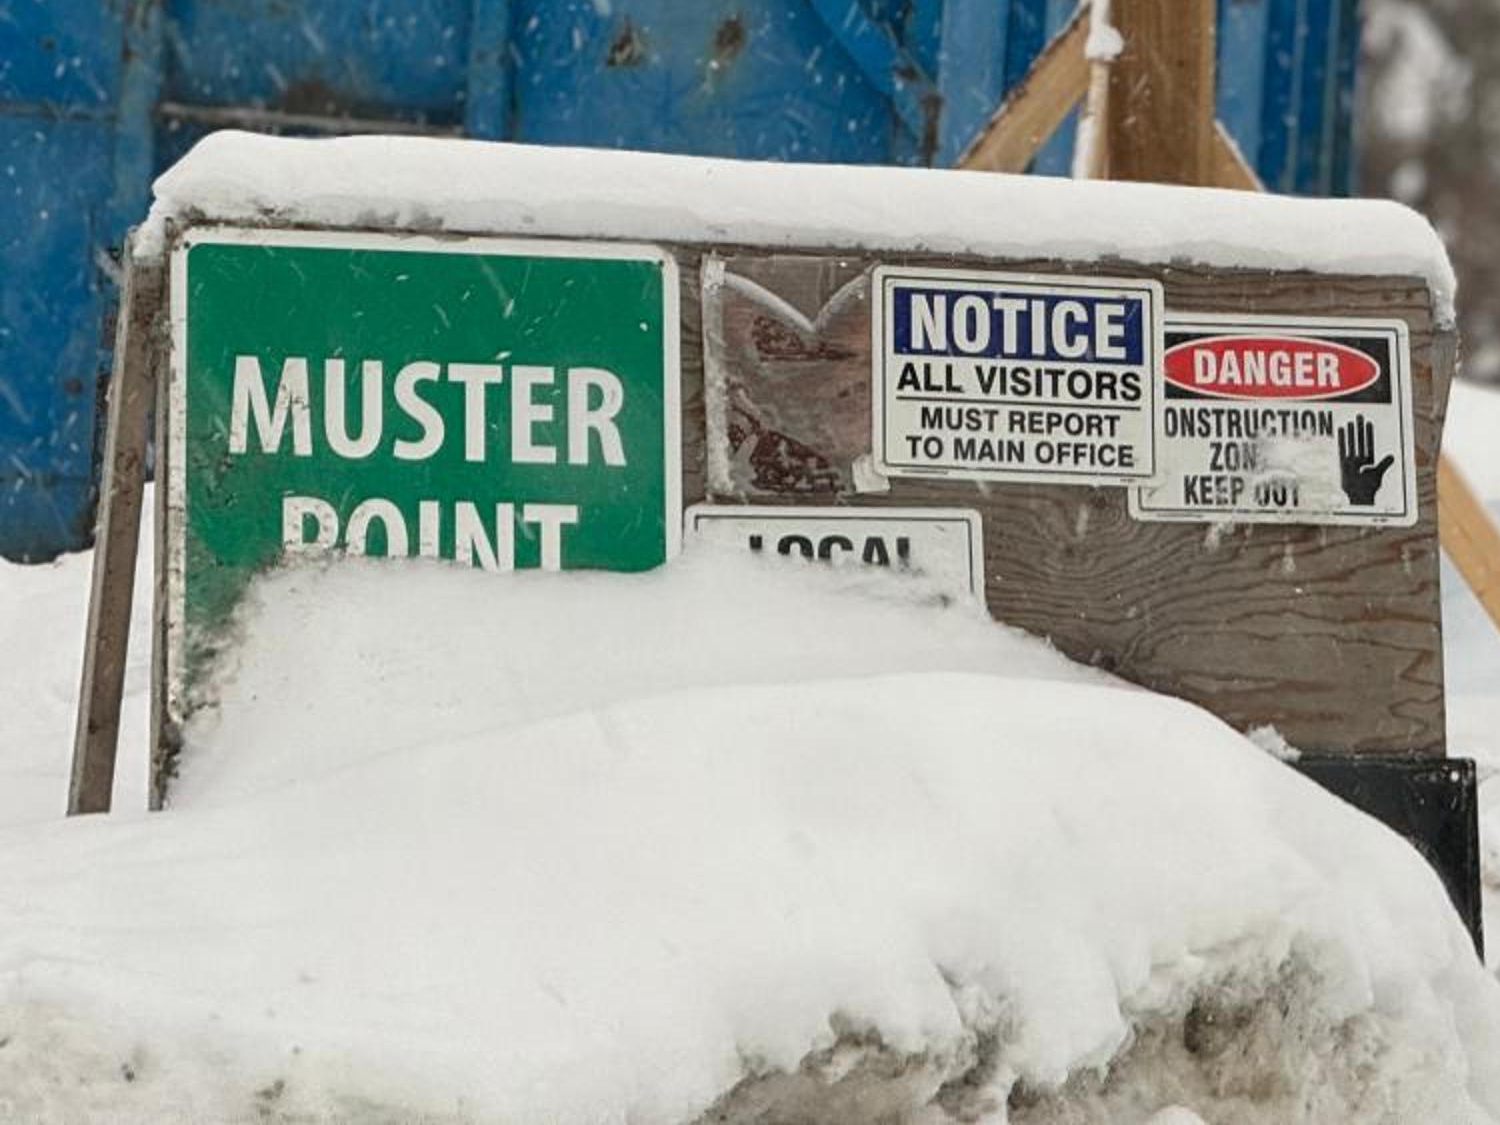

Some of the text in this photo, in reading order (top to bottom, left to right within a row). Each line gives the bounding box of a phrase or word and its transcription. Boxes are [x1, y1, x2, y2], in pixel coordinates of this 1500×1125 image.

[910, 293, 1127, 360] NOTICE
[898, 362, 1142, 402] ALL VISITORS
[1193, 349, 1341, 388] DANGER
[228, 354, 628, 467] MUSTER
[921, 406, 1121, 438] MUST REPORT
[1164, 406, 1334, 439] ONSTRUCTION
[906, 435, 1135, 469] TO MAIN OFFICE
[1209, 441, 1258, 473] ZON
[1183, 474, 1245, 507] KEEP
[280, 495, 579, 571] POINT
